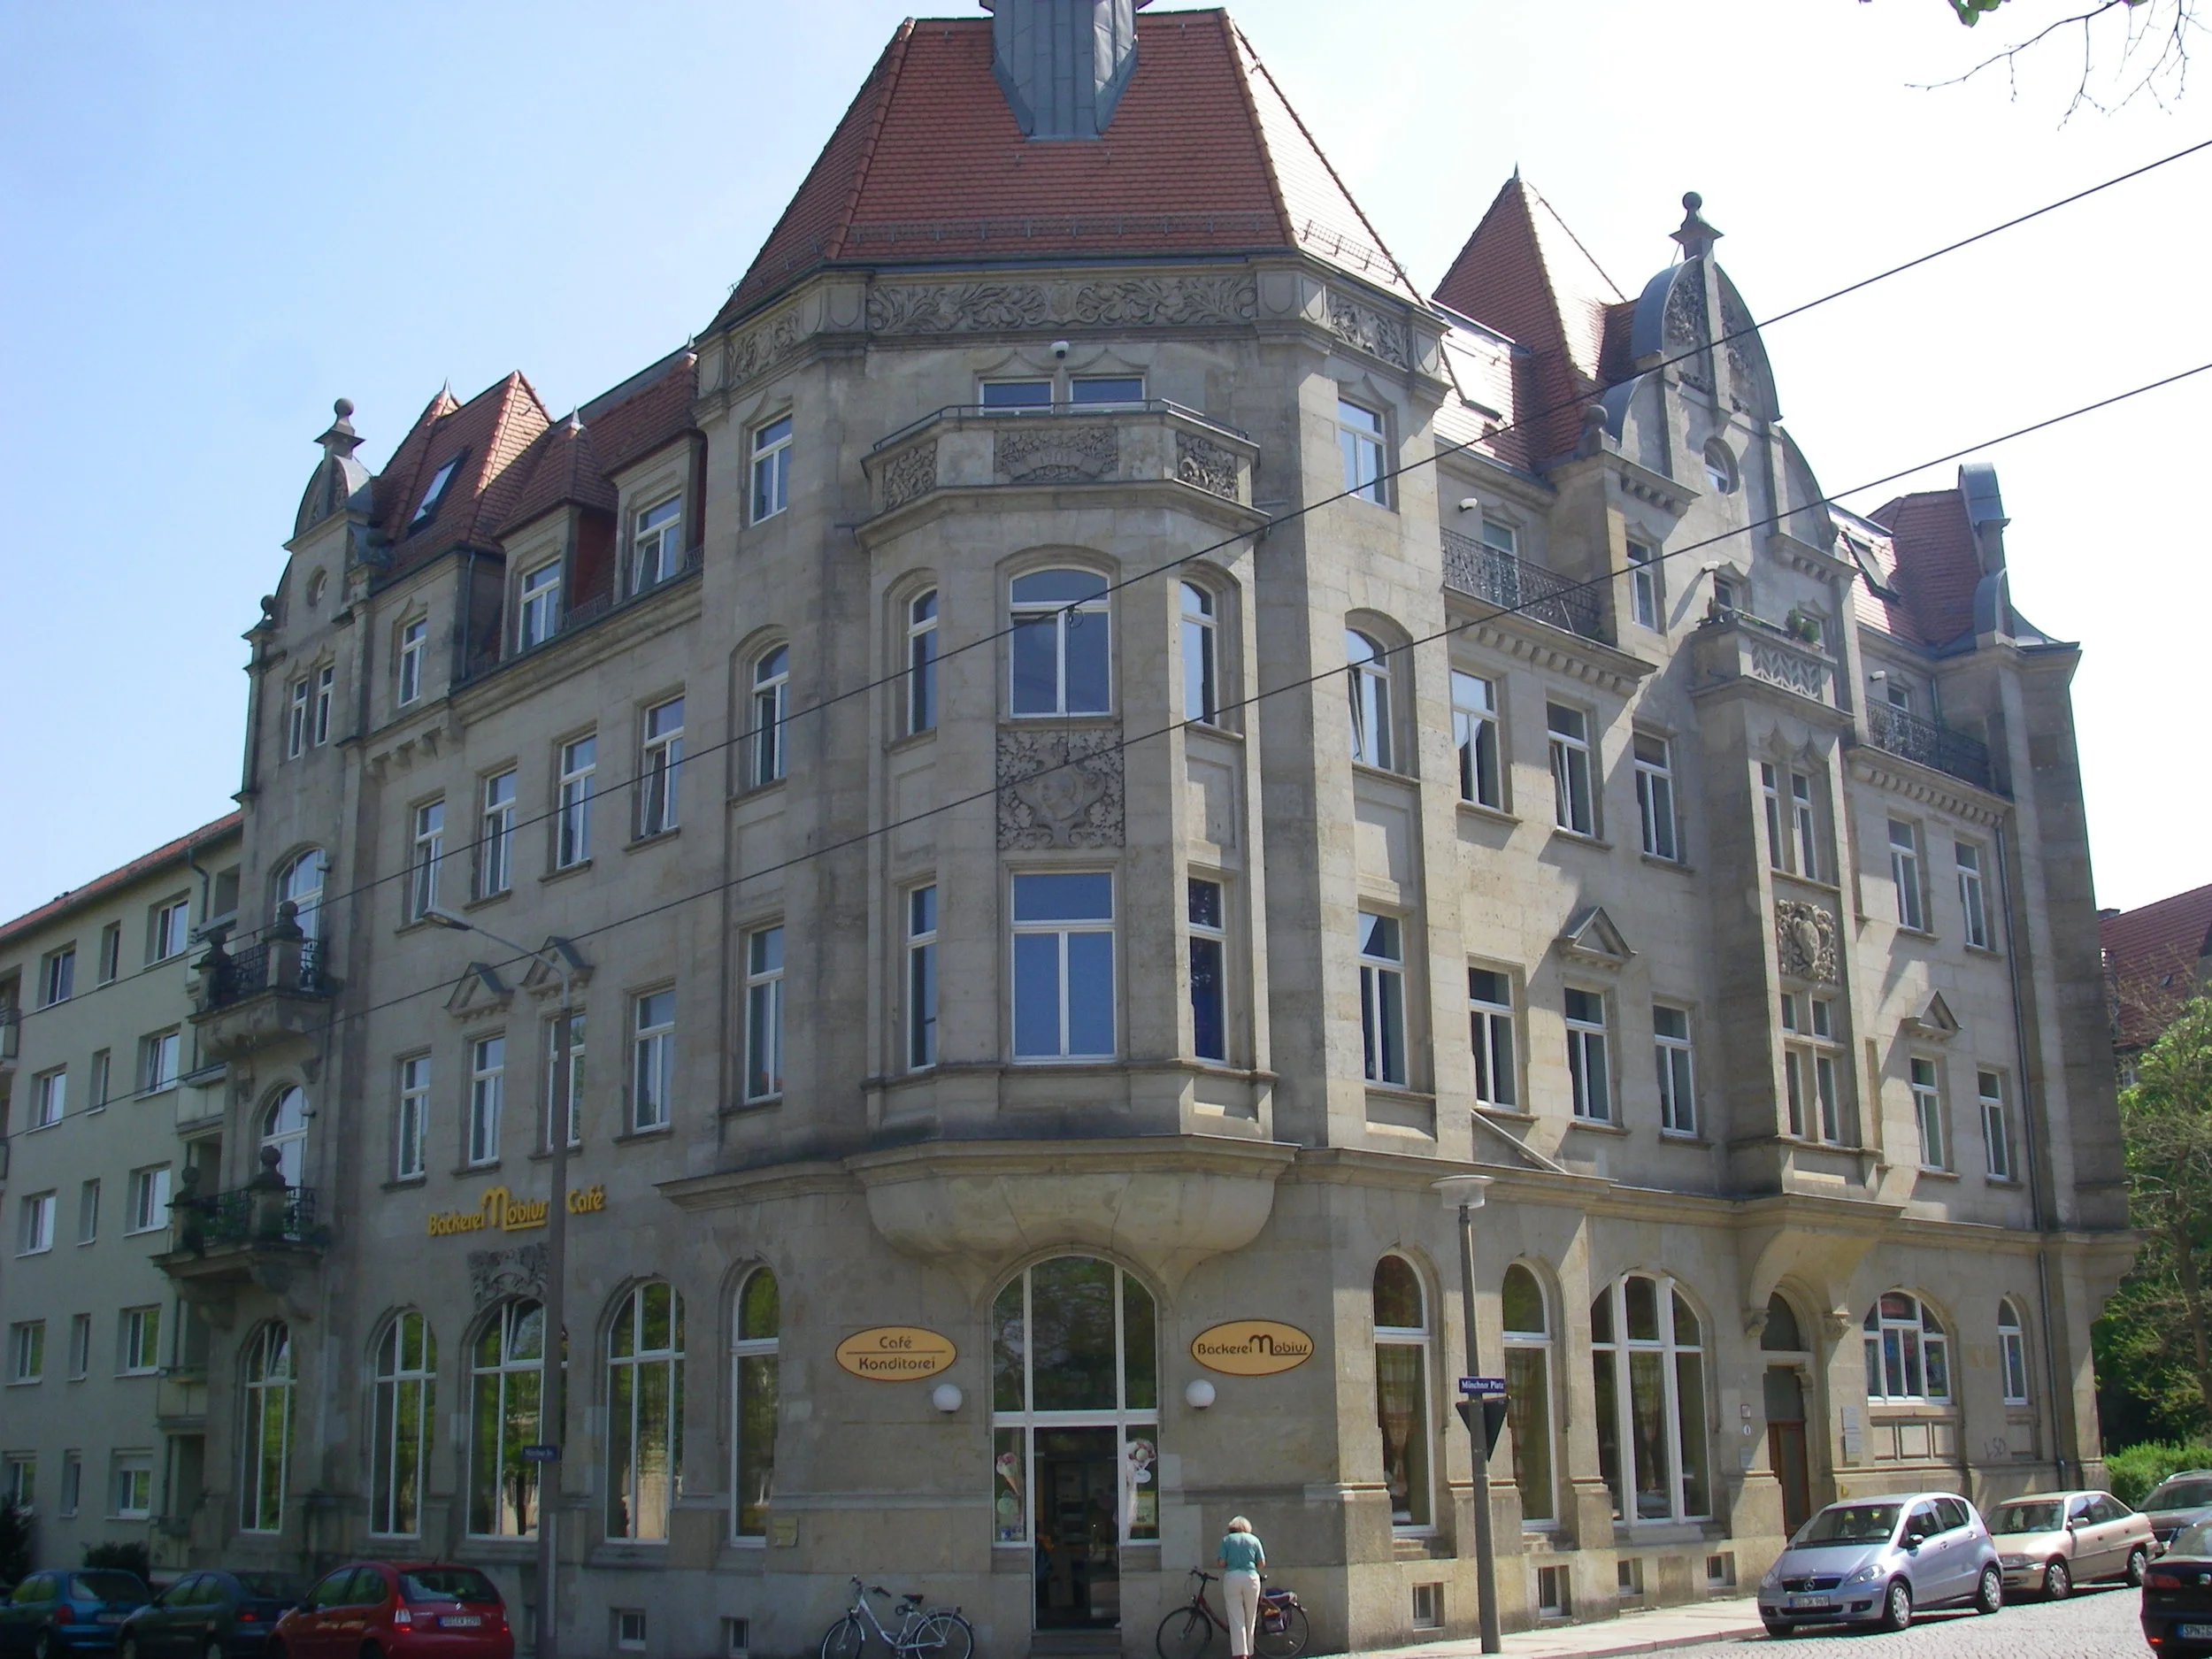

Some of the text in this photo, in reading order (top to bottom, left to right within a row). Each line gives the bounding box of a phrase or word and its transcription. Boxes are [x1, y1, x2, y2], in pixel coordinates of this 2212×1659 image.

[480, 1185, 549, 1232] Möbius
[566, 1184, 605, 1214] Café
[879, 1335, 912, 1349] Café
[858, 1356, 935, 1371] Konditorei
